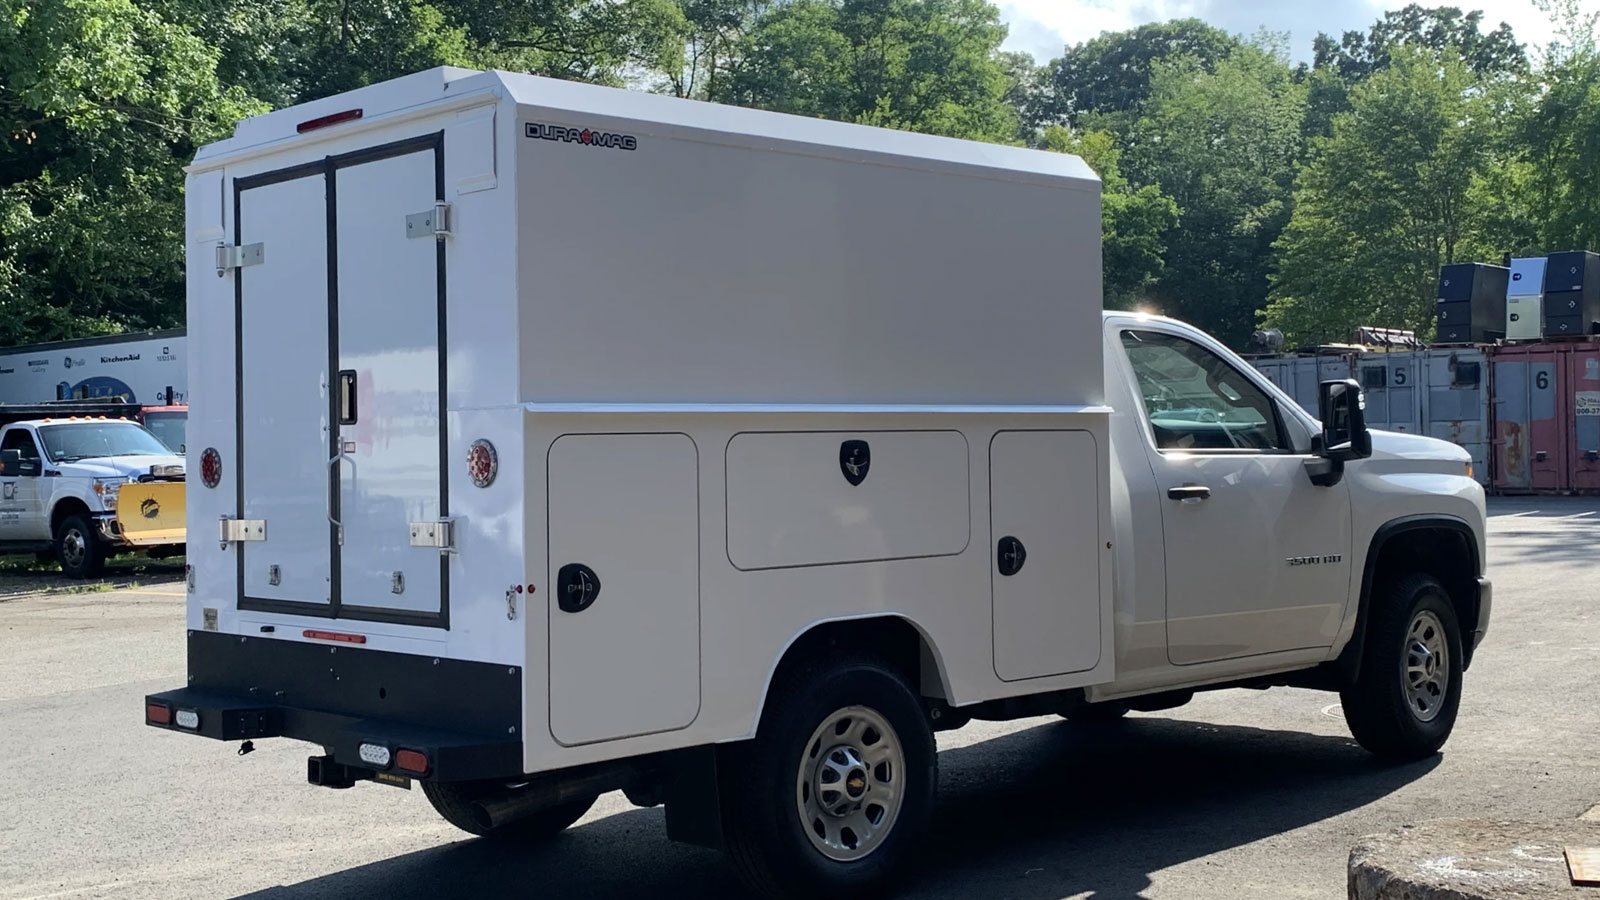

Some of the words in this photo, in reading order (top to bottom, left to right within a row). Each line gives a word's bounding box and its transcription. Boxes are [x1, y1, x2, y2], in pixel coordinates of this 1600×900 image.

[100, 354, 140, 364] KitchenAid
[1394, 367, 1406, 385] 5
[1536, 371, 1549, 389] 6
